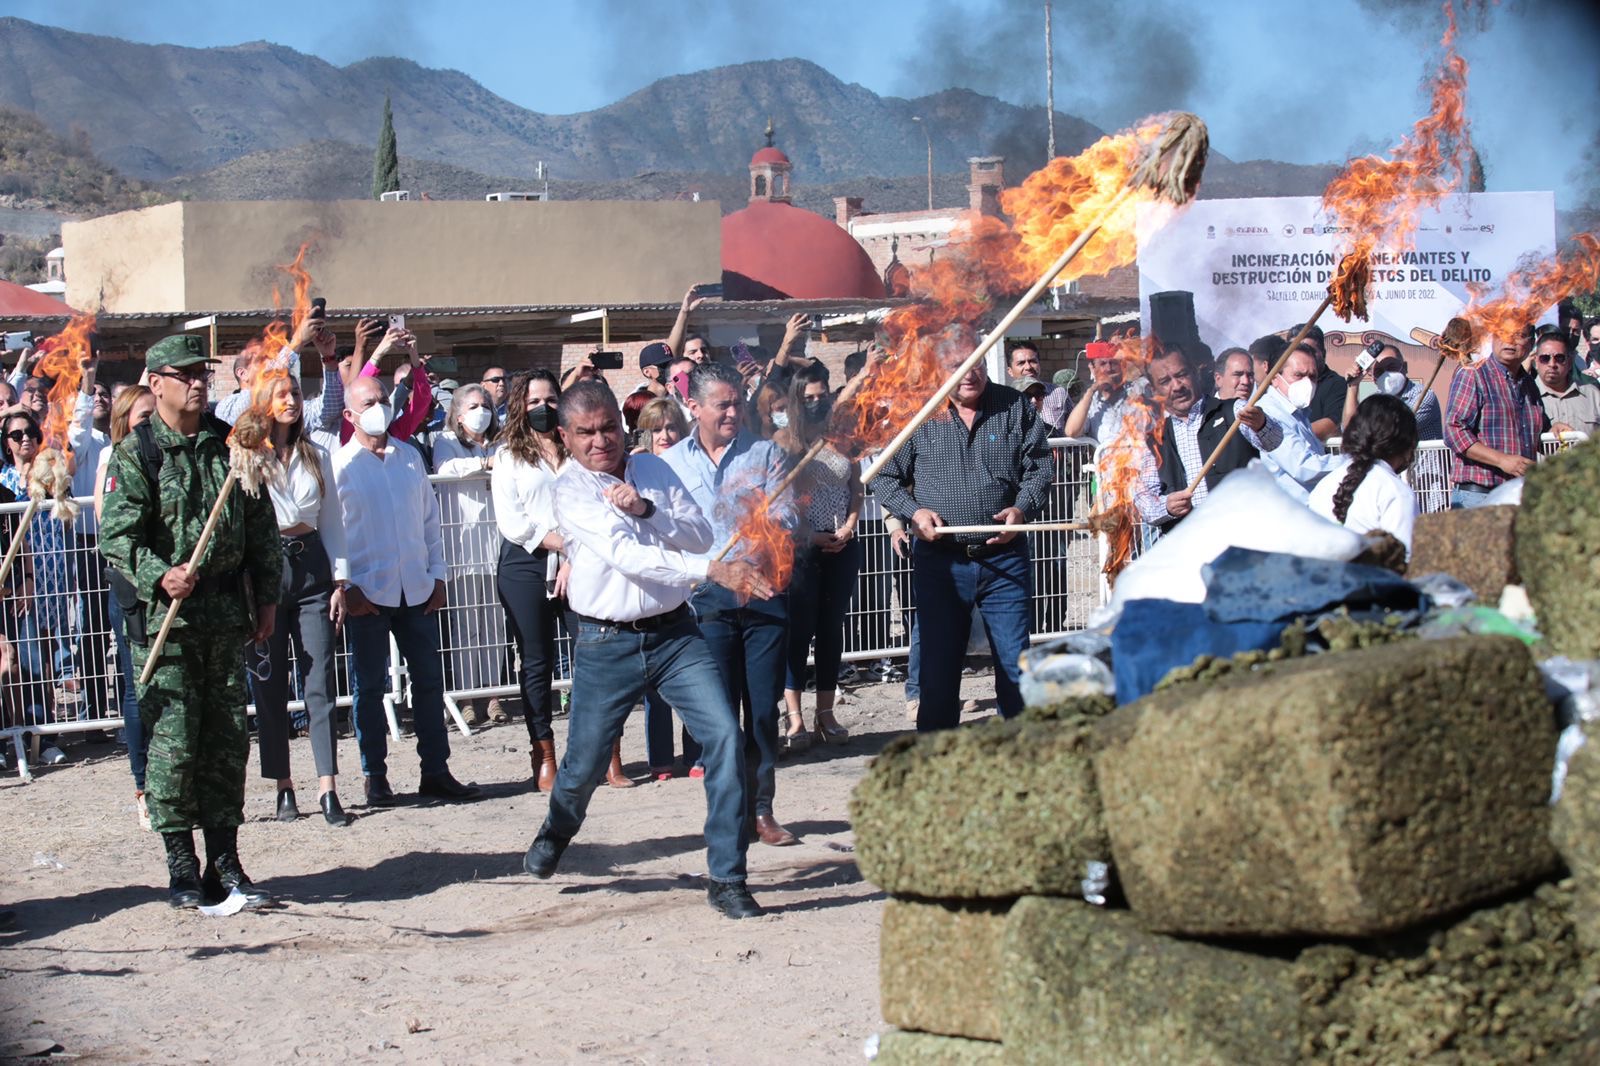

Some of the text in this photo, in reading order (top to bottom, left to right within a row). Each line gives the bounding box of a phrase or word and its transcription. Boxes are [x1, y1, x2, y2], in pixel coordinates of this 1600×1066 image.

[1231, 250, 1335, 268] INCINERACIÓN
[1368, 251, 1456, 265] NERVANTES
[1461, 251, 1471, 264] Y
[1211, 268, 1312, 285] DESTRUCCIÓN
[1369, 269, 1405, 283] ETOS
[1410, 269, 1438, 282] DEL
[1442, 268, 1492, 282] DELITO
[1267, 290, 1299, 302] SALTILLO,
[1385, 289, 1406, 300] JUNIO
[1408, 289, 1417, 299] DE
